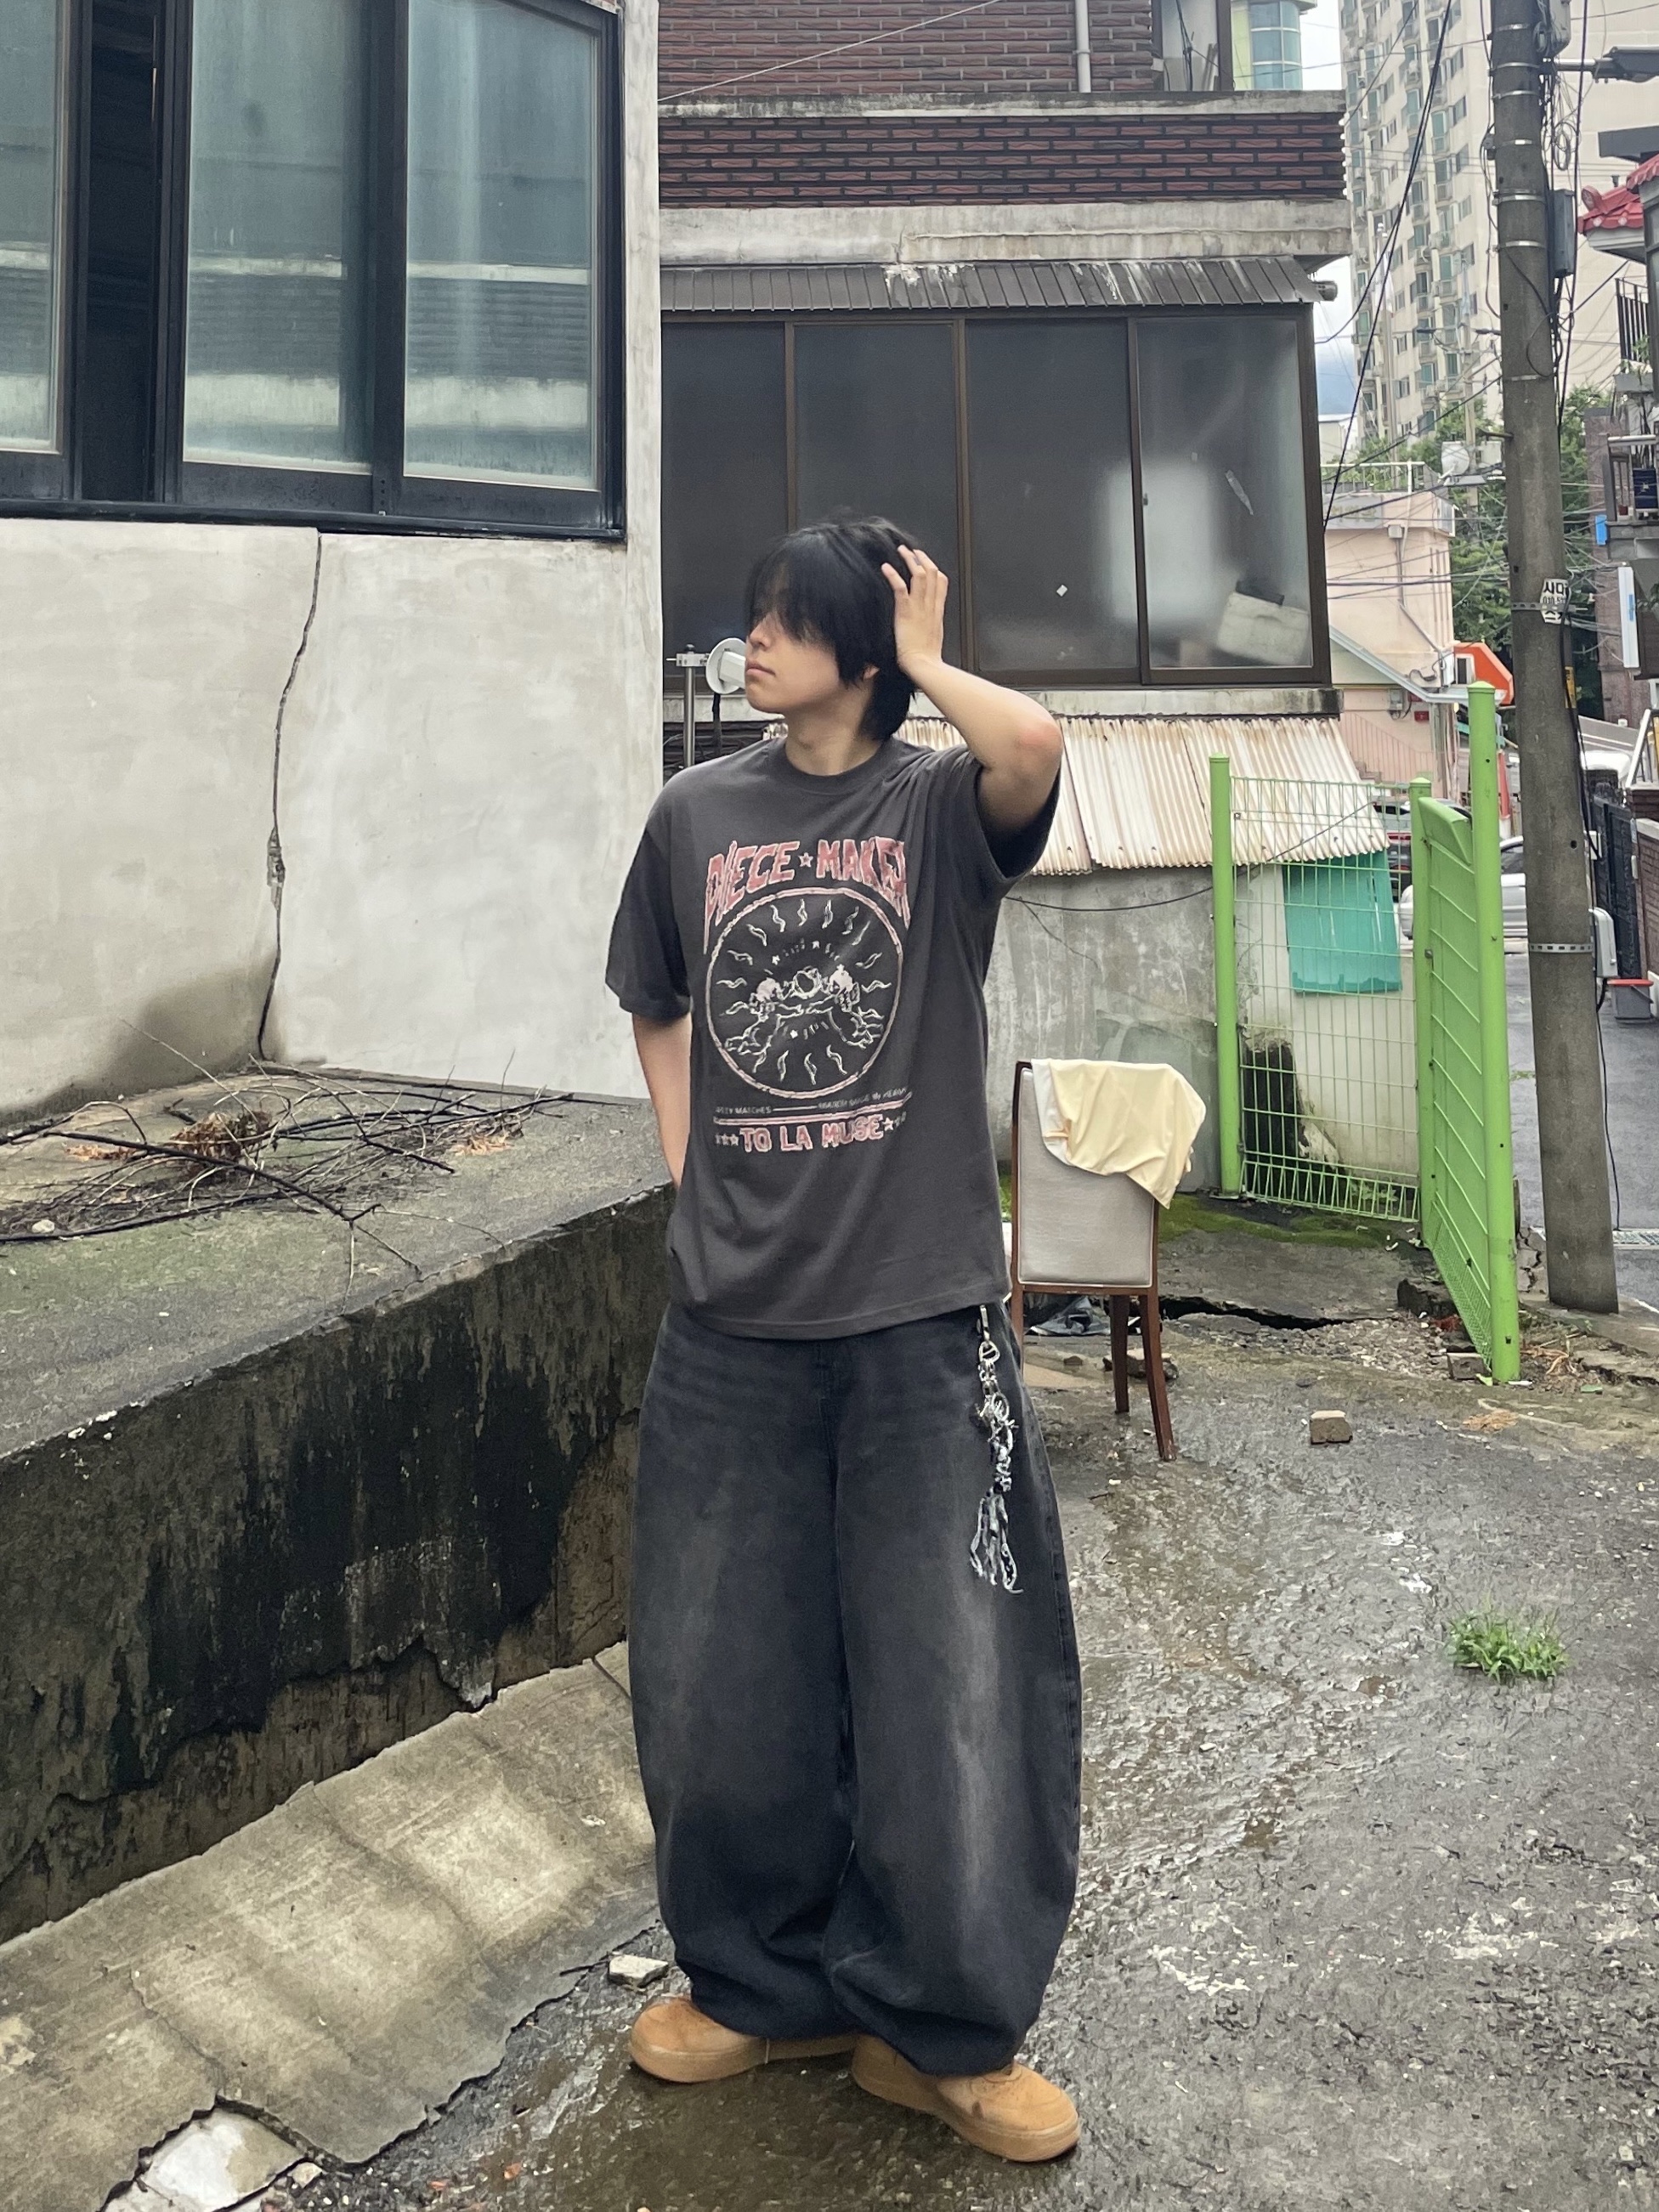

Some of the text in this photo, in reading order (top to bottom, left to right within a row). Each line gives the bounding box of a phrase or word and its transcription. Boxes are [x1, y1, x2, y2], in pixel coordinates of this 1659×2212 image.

[1543, 581, 1568, 596] 사다
[703, 840, 801, 955] PIECE
[739, 1114, 885, 1152] TO LA MUSE
